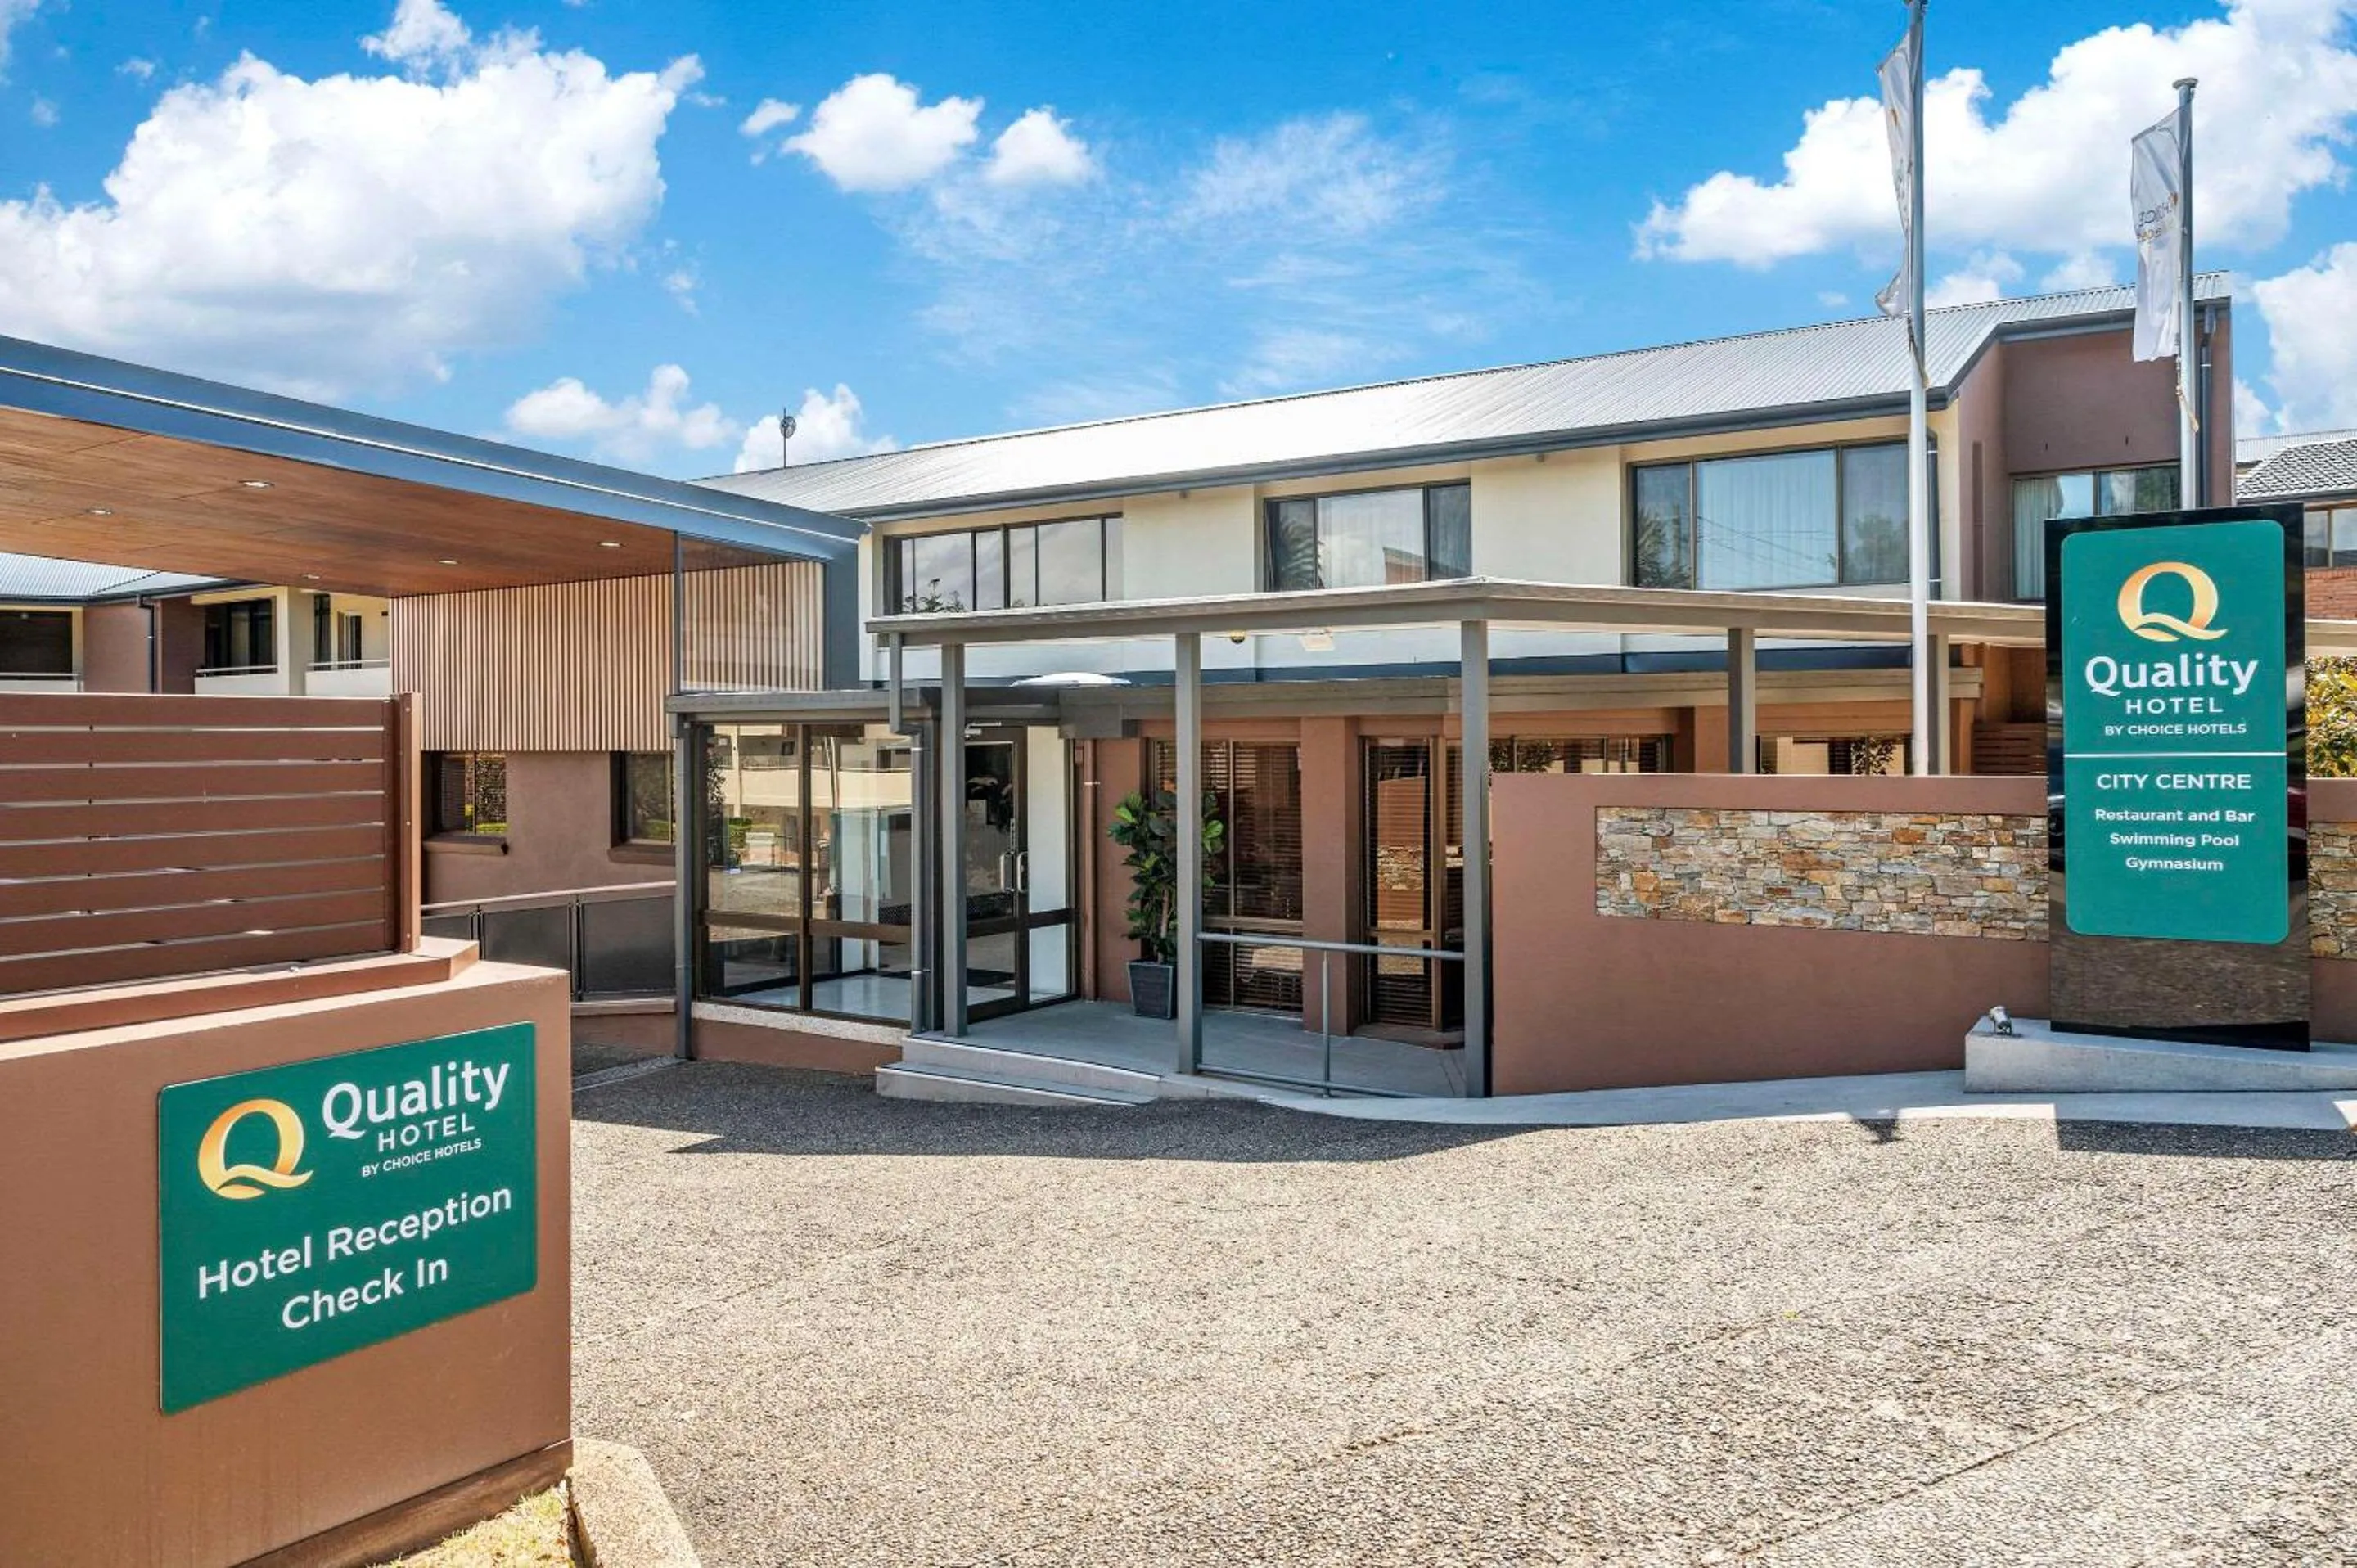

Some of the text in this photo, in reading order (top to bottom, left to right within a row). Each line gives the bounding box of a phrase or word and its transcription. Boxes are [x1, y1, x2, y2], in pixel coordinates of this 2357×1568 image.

[2085, 652, 2258, 696] Quality
[2126, 697, 2224, 714] HOTEL
[2105, 723, 2247, 735] BY CHOICE HOTELS
[2097, 773, 2251, 789] CITY CENTRE
[2095, 809, 2255, 822] Restaurant and Bar
[2110, 832, 2239, 848] Swimming Pool
[2125, 857, 2224, 872] Gymnasium
[322, 1061, 510, 1140] Quality
[378, 1113, 475, 1152] HOTEL
[362, 1138, 482, 1178] BY CHOICE HOTELS
[199, 1188, 512, 1299] Hotel Reception
[282, 1259, 448, 1330] Check In
